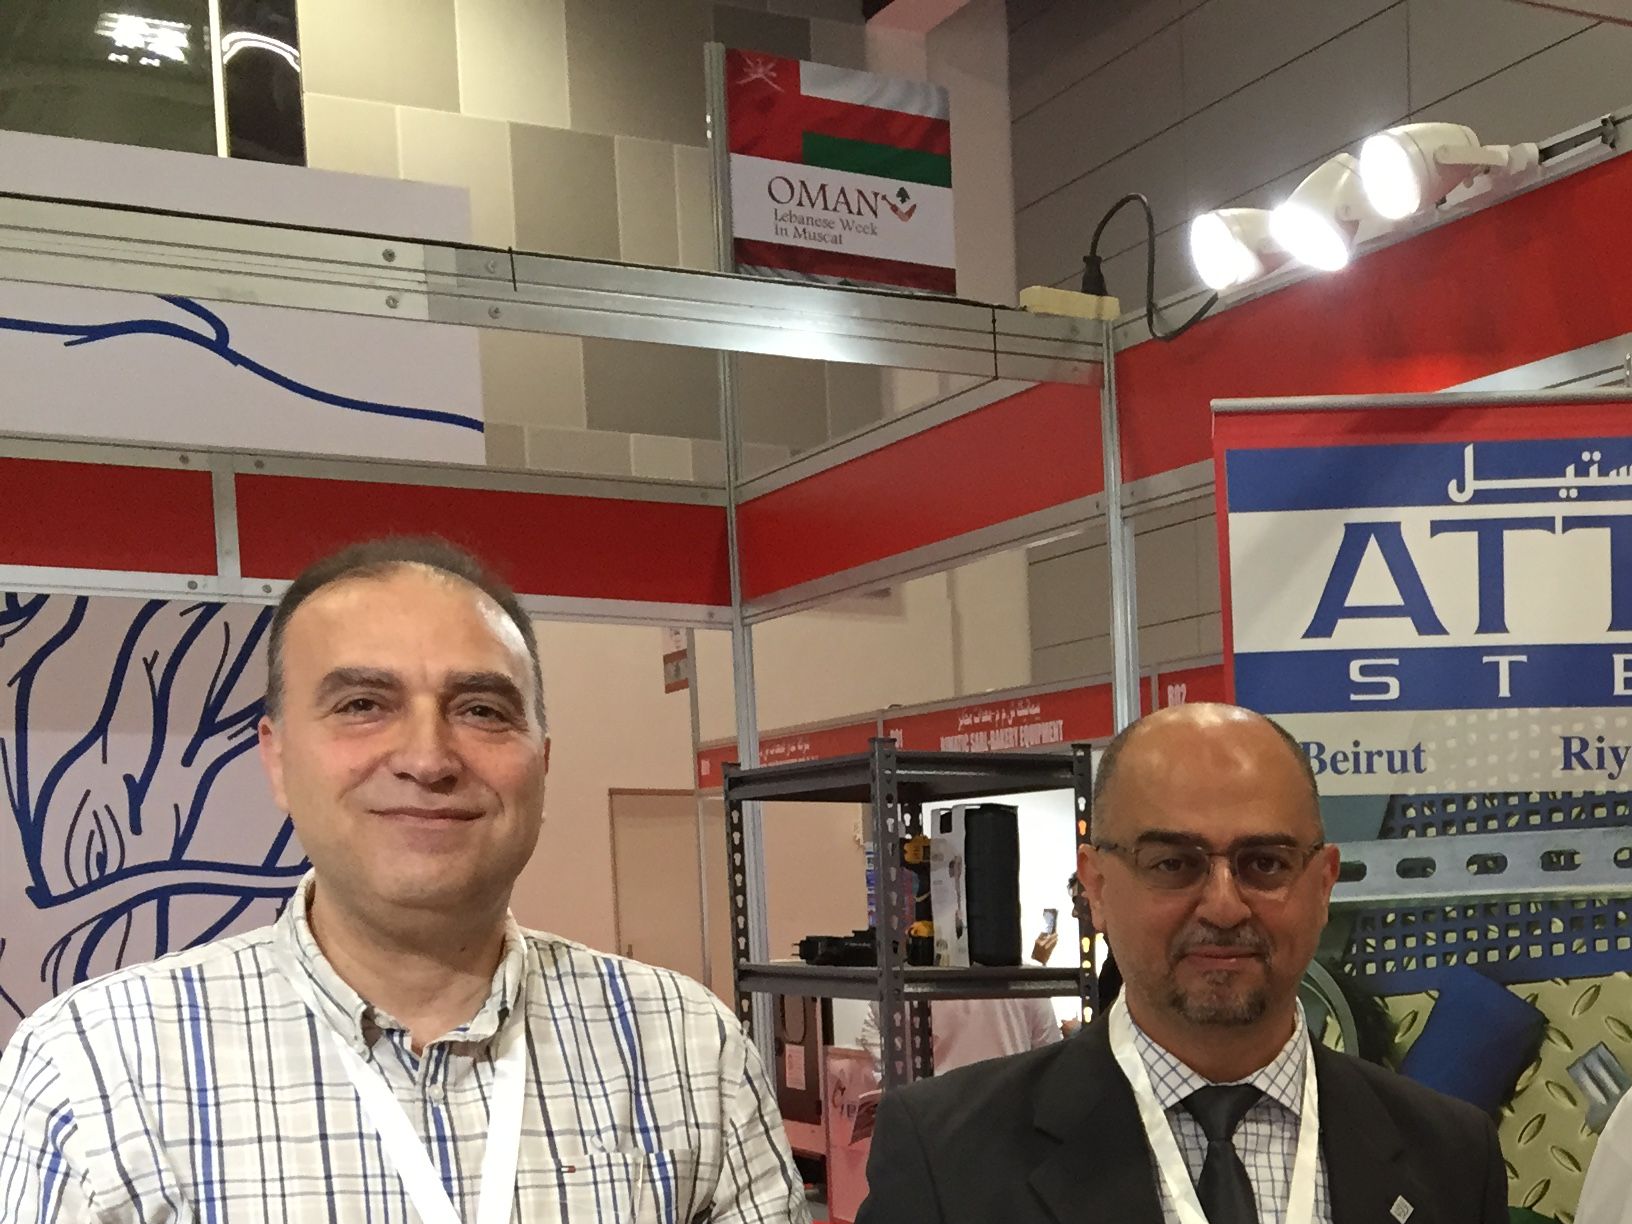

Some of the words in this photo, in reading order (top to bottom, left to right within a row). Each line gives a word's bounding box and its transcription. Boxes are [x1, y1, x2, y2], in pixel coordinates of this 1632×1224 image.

[768, 176, 880, 219] OMAN
[774, 208, 836, 230] Lebanese
[839, 217, 879, 236] Week
[792, 227, 843, 245] Muscat
[1301, 739, 1427, 777] Beirut
